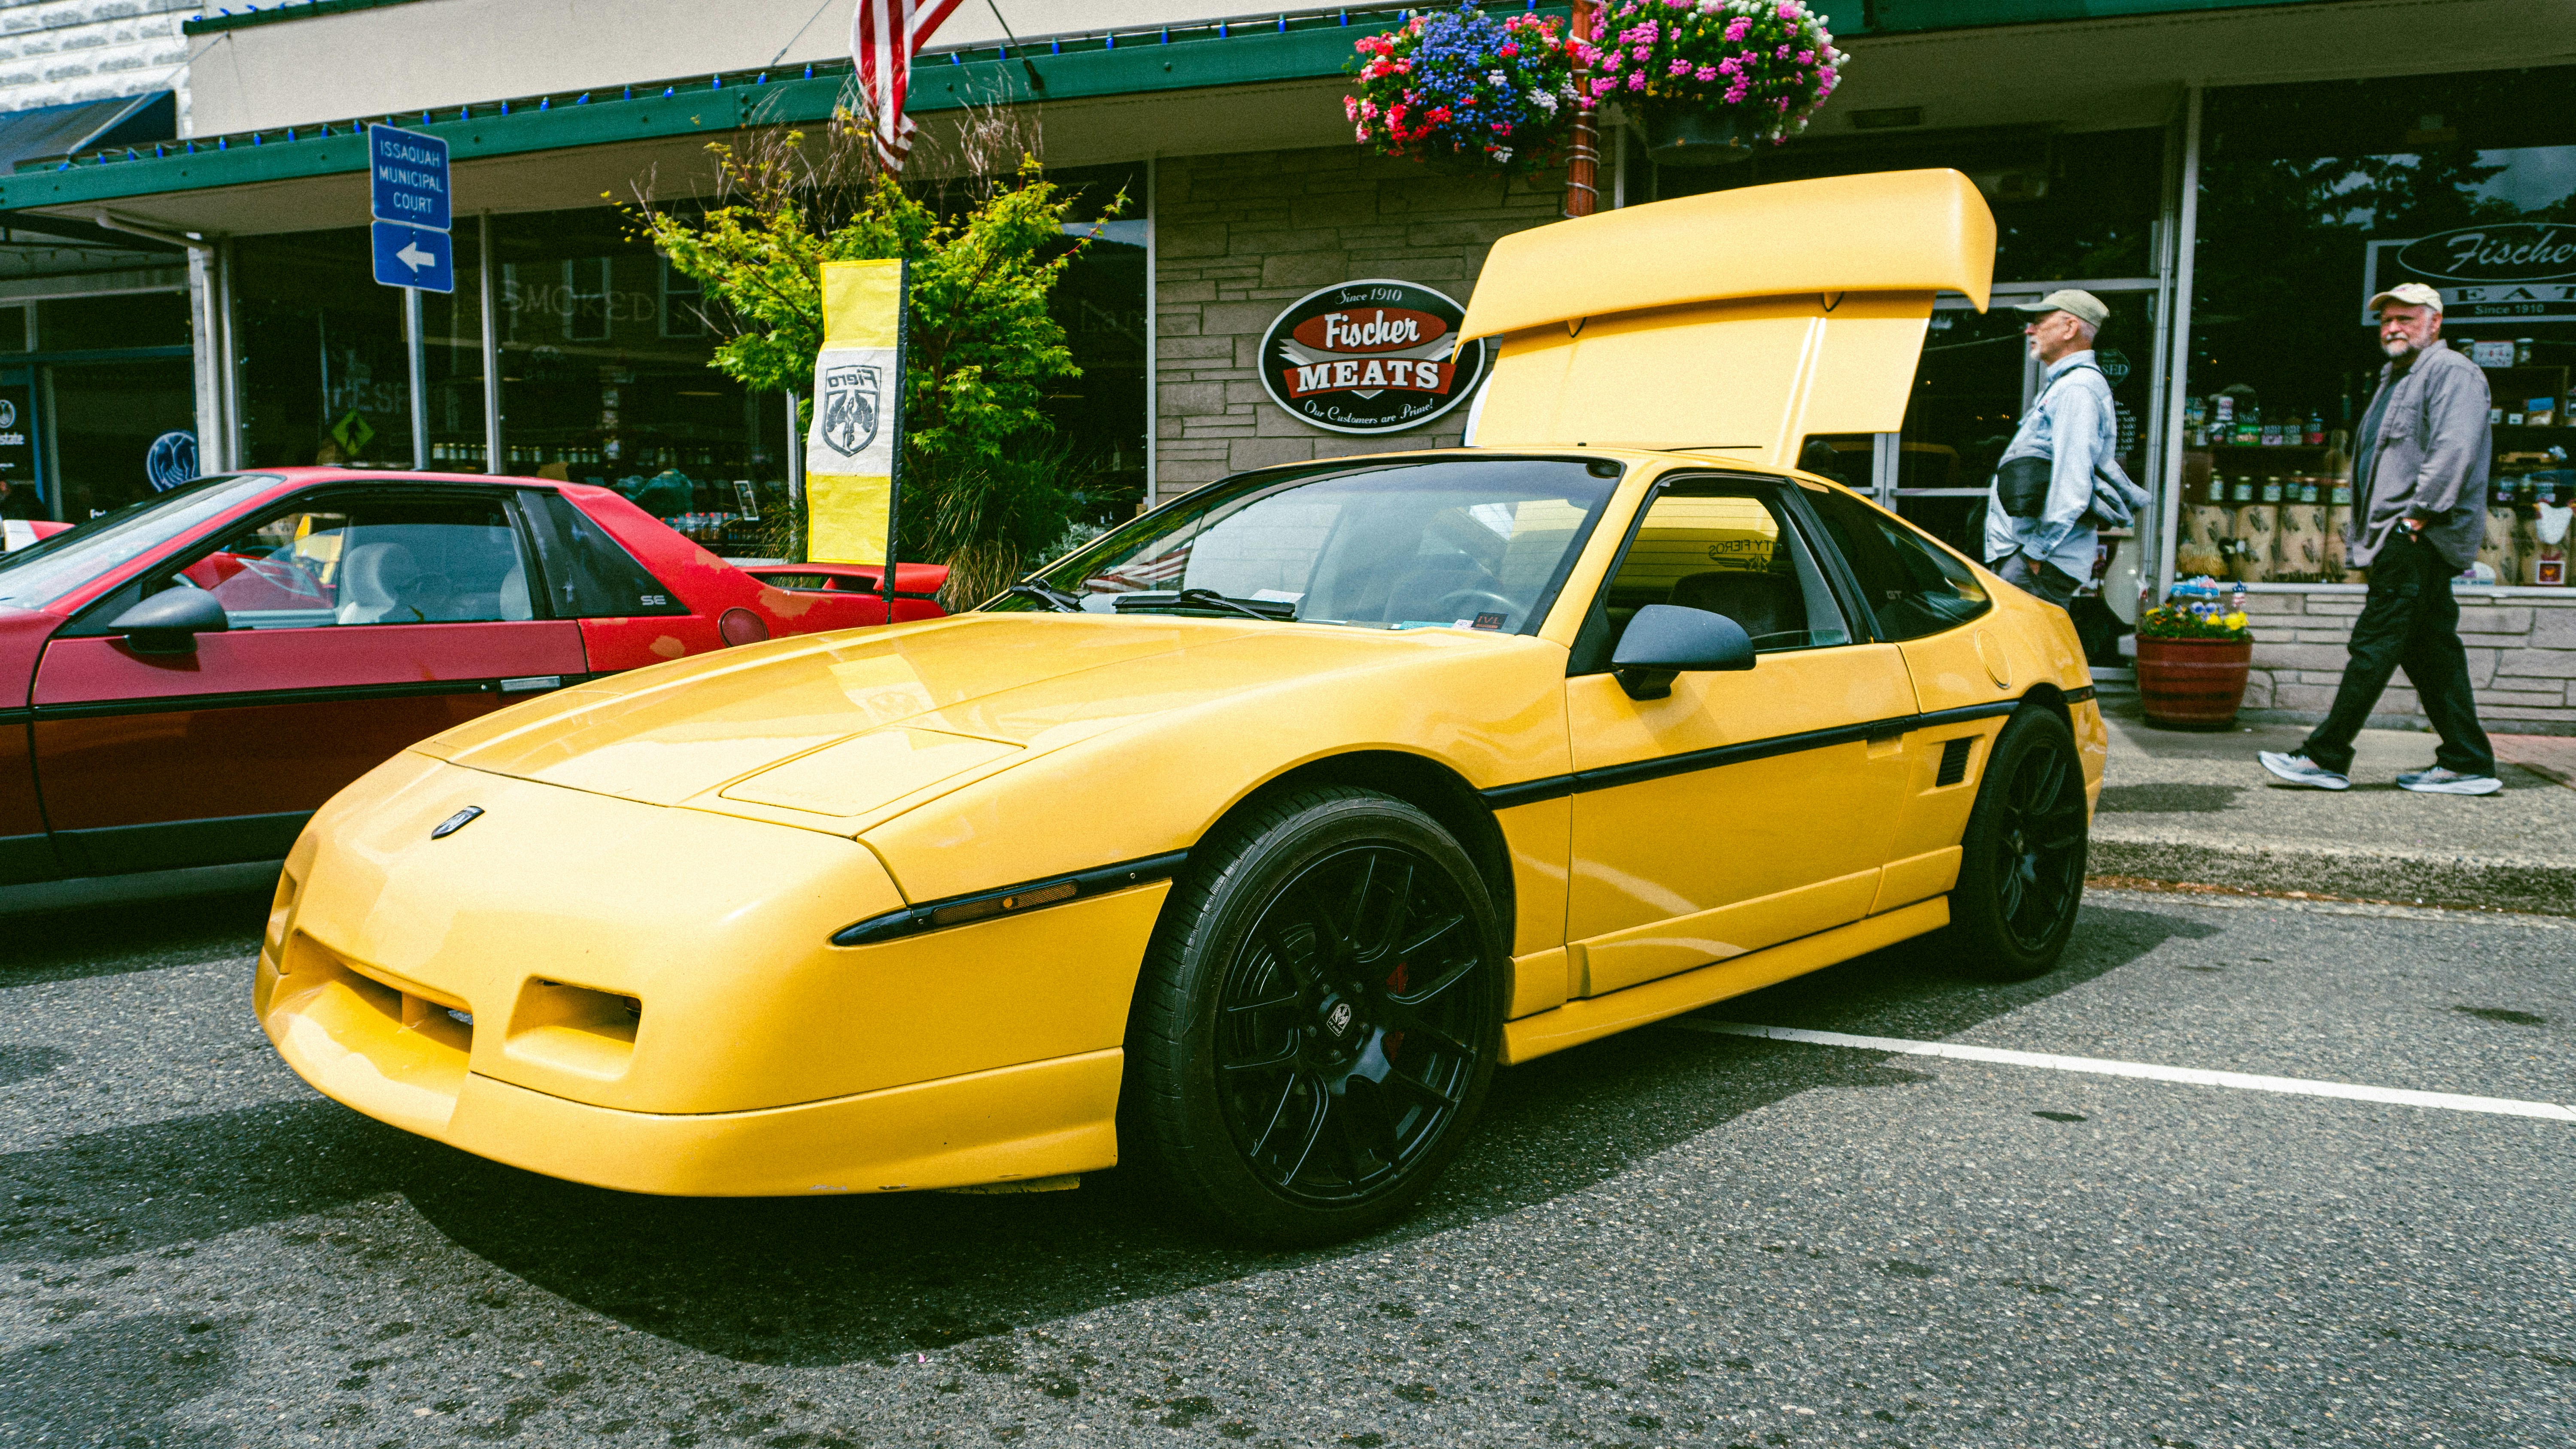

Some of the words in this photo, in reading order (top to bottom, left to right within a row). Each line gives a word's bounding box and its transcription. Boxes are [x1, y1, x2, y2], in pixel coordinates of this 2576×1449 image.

[381, 139, 439, 166] ISSAQUAH
[379, 166, 443, 192] MUNICIPAL
[394, 193, 431, 213] COURT
[2446, 230, 2576, 273] Fische
[501, 279, 656, 321] SMOKED
[1335, 289, 1367, 305] Since
[1370, 288, 1403, 301] 1910
[2457, 286, 2576, 303] EAT
[2475, 305, 2509, 315] Since
[2515, 304, 2544, 313] 1910
[1324, 309, 1420, 349] Fischer
[1296, 360, 1438, 393] MEATS
[1304, 400, 1324, 418] Our
[1327, 407, 1378, 424] Customers
[1381, 414, 1396, 423] are
[1399, 398, 1433, 419] Prime!
[0, 432, 24, 445] state
[641, 594, 666, 605] SE
